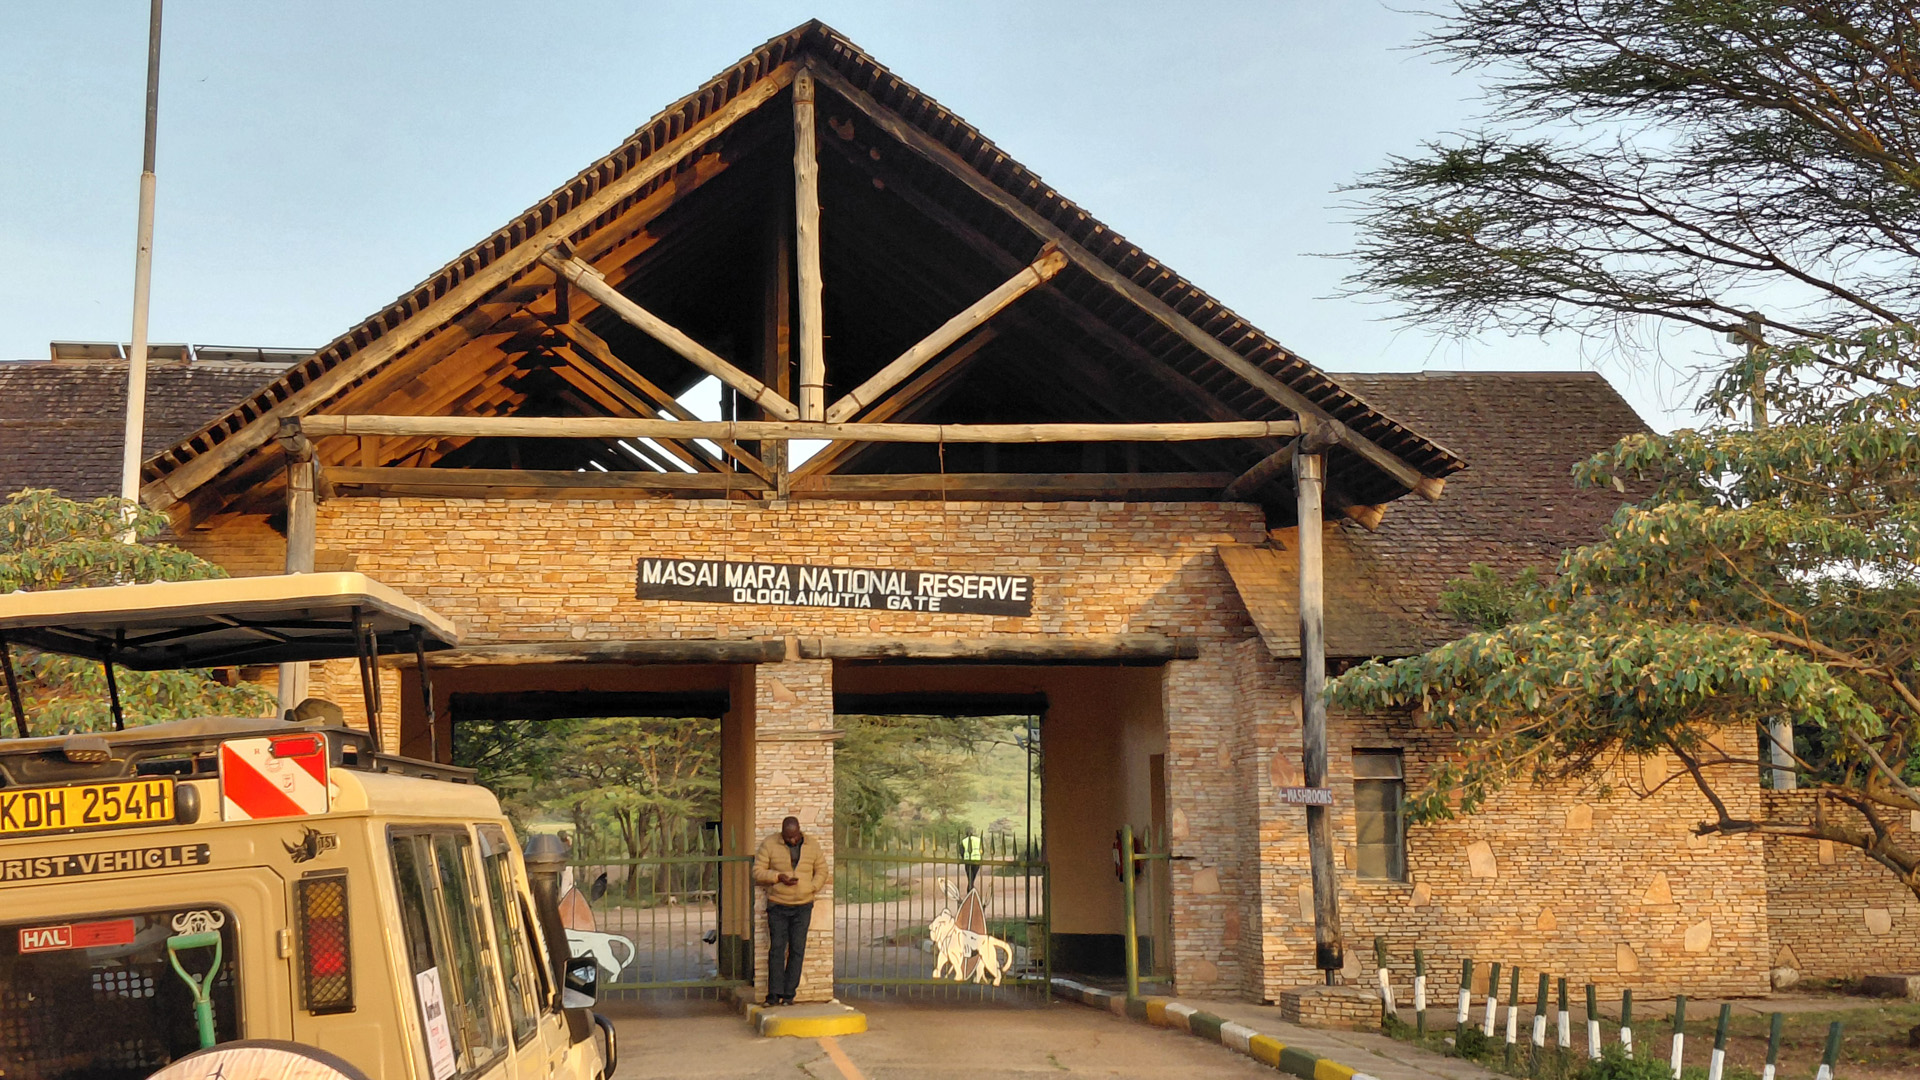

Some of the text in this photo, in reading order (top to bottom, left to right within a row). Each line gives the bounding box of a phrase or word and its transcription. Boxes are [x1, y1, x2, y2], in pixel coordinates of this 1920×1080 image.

[642, 560, 1027, 601] MASAI MARA NATIONAL RESERVE
[733, 588, 942, 612] OLOOLAIMUTIA GATE
[0, 782, 166, 830] KDH 254H
[1287, 788, 1333, 804] WASHROOMS
[319, 836, 337, 849] TSV
[0, 845, 198, 880] RIST VEHICLE
